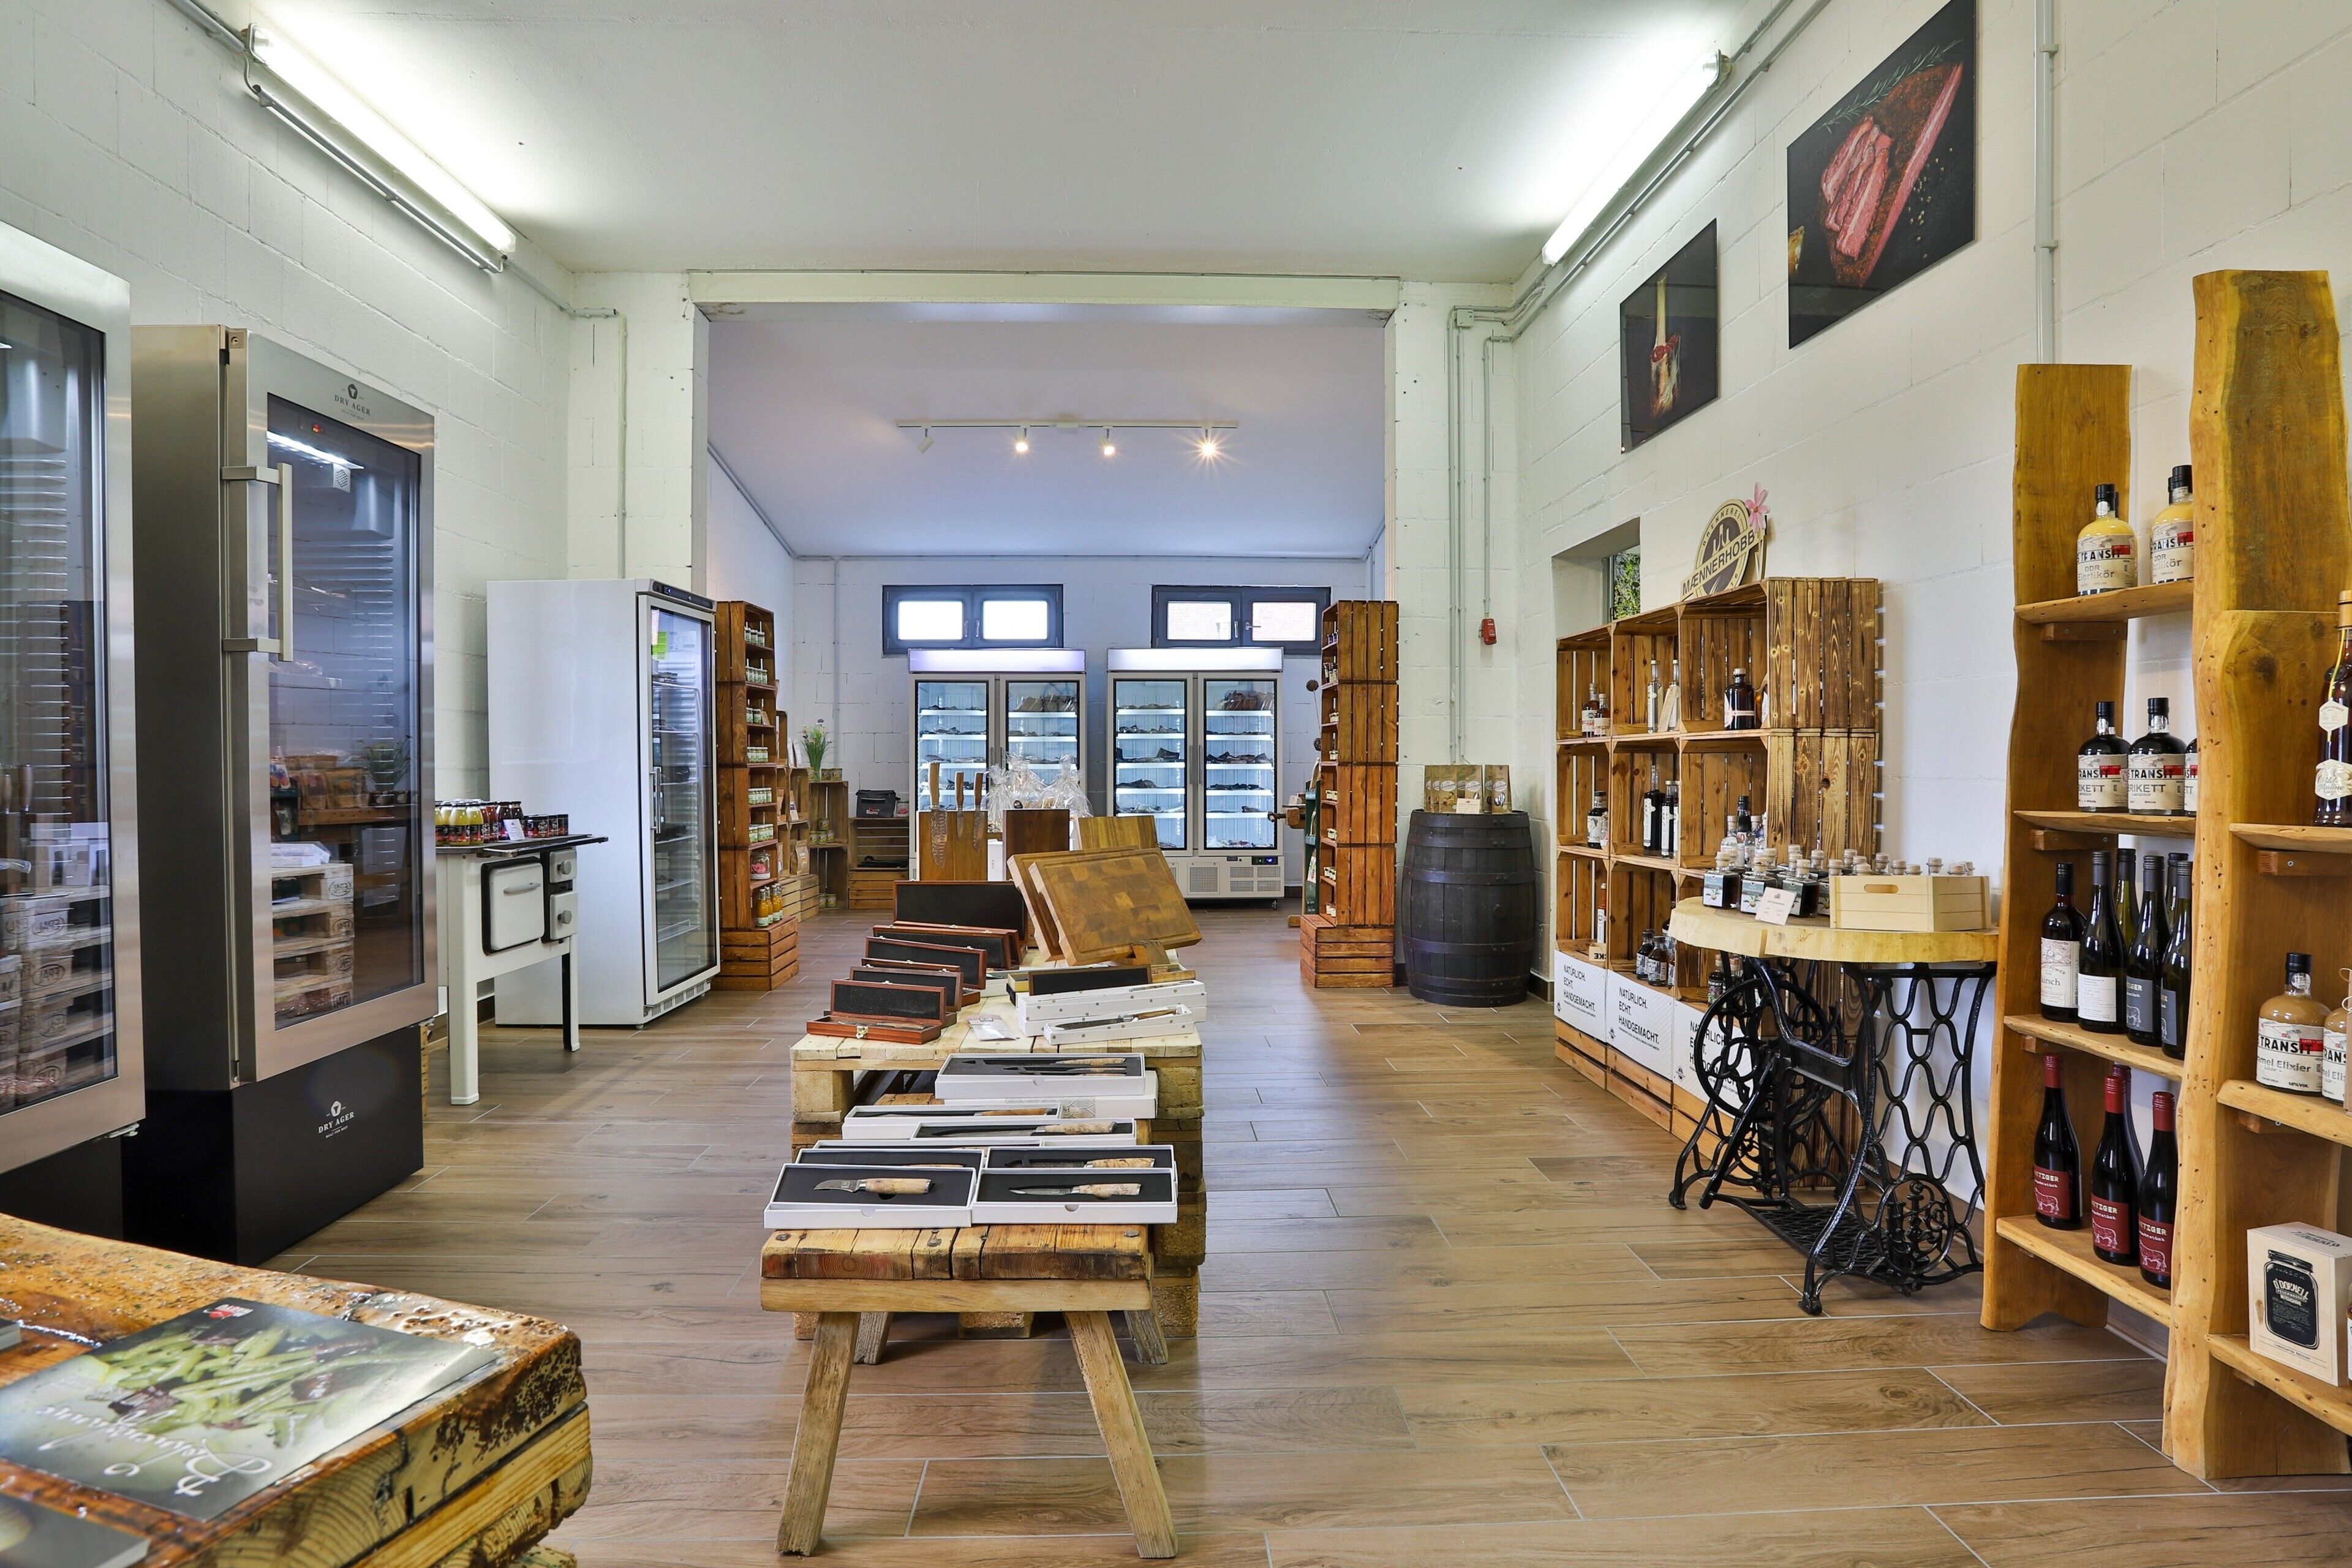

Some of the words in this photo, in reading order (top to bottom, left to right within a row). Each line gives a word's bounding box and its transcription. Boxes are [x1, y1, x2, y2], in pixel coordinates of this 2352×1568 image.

[334, 394, 349, 406] DRY
[352, 402, 371, 416] AGER
[1702, 508, 1741, 546] BRENNEREI
[1683, 529, 1760, 596] MÆNNERHOBB
[2132, 769, 2173, 778] TRANSIT
[1564, 963, 1586, 981] NATÜRLICH.
[1564, 976, 1574, 989] ECHT.
[1564, 989, 1596, 1012] HANDGEMACHT.
[1619, 987, 1648, 1009] NATÜRLICH.
[1619, 1001, 1631, 1016] ECHT.
[1618, 1015, 1659, 1045] HANDGEMACHT.
[2261, 1036, 2312, 1054] TRANSIT
[2277, 1060, 2312, 1072] Elixier
[318, 1121, 333, 1134] DRY
[335, 1112, 355, 1126] AGER
